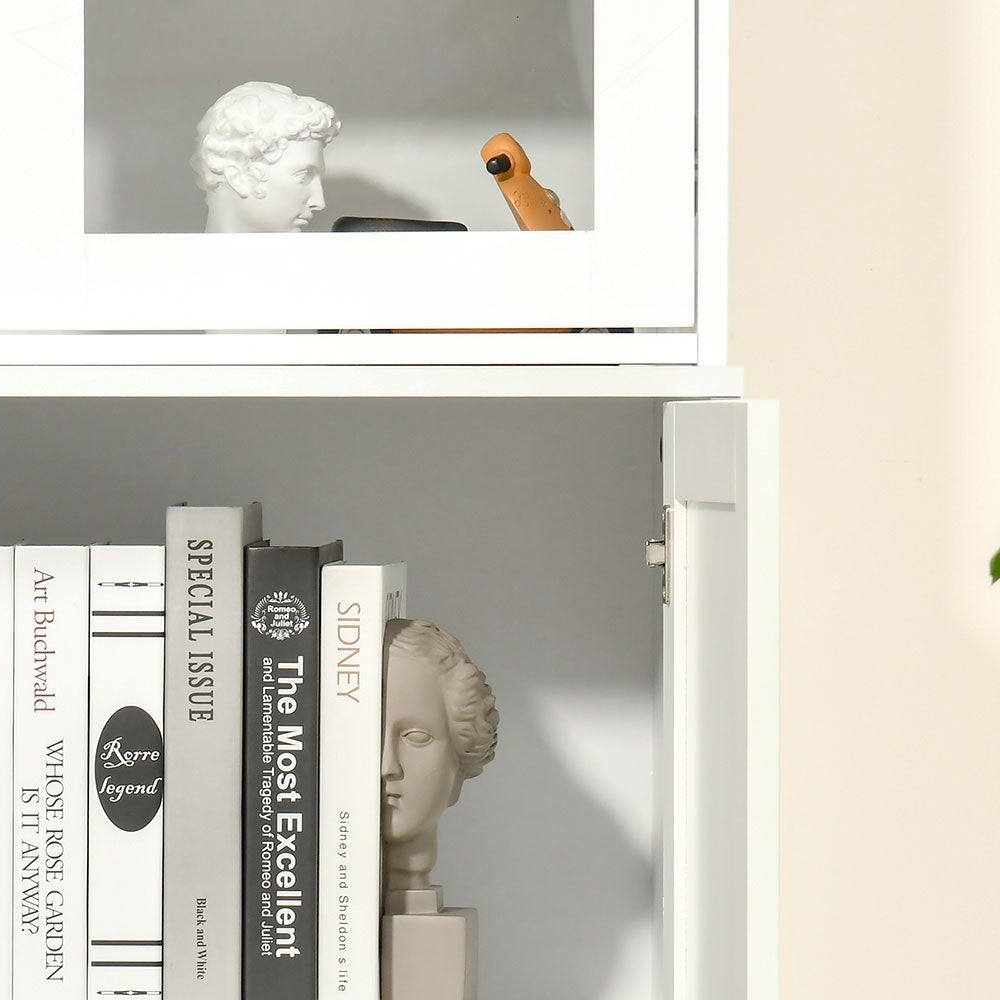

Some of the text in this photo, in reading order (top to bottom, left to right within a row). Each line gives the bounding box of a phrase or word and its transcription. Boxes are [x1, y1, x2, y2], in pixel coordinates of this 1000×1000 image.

[33, 566, 56, 713] Art Buchwald
[187, 539, 215, 723] SPECIAL ISSUE
[267, 605, 296, 613] Romeo
[270, 619, 294, 628] Juliet
[273, 612, 290, 620] and
[337, 601, 361, 704] SIDNEY
[99, 776, 163, 803] legend
[259, 657, 275, 957] and Lamentable Tragedy of Romeo and Juliet
[276, 656, 304, 958] The Most Excellent
[21, 786, 40, 935] IS IT ANYWAY?
[45, 738, 65, 982] WHOSE ROSE GARDEN
[337, 810, 350, 859] Sidney
[338, 864, 349, 889] and
[196, 897, 208, 980] Black and White
[338, 894, 350, 951] Sheldon
[337, 970, 349, 992] life
